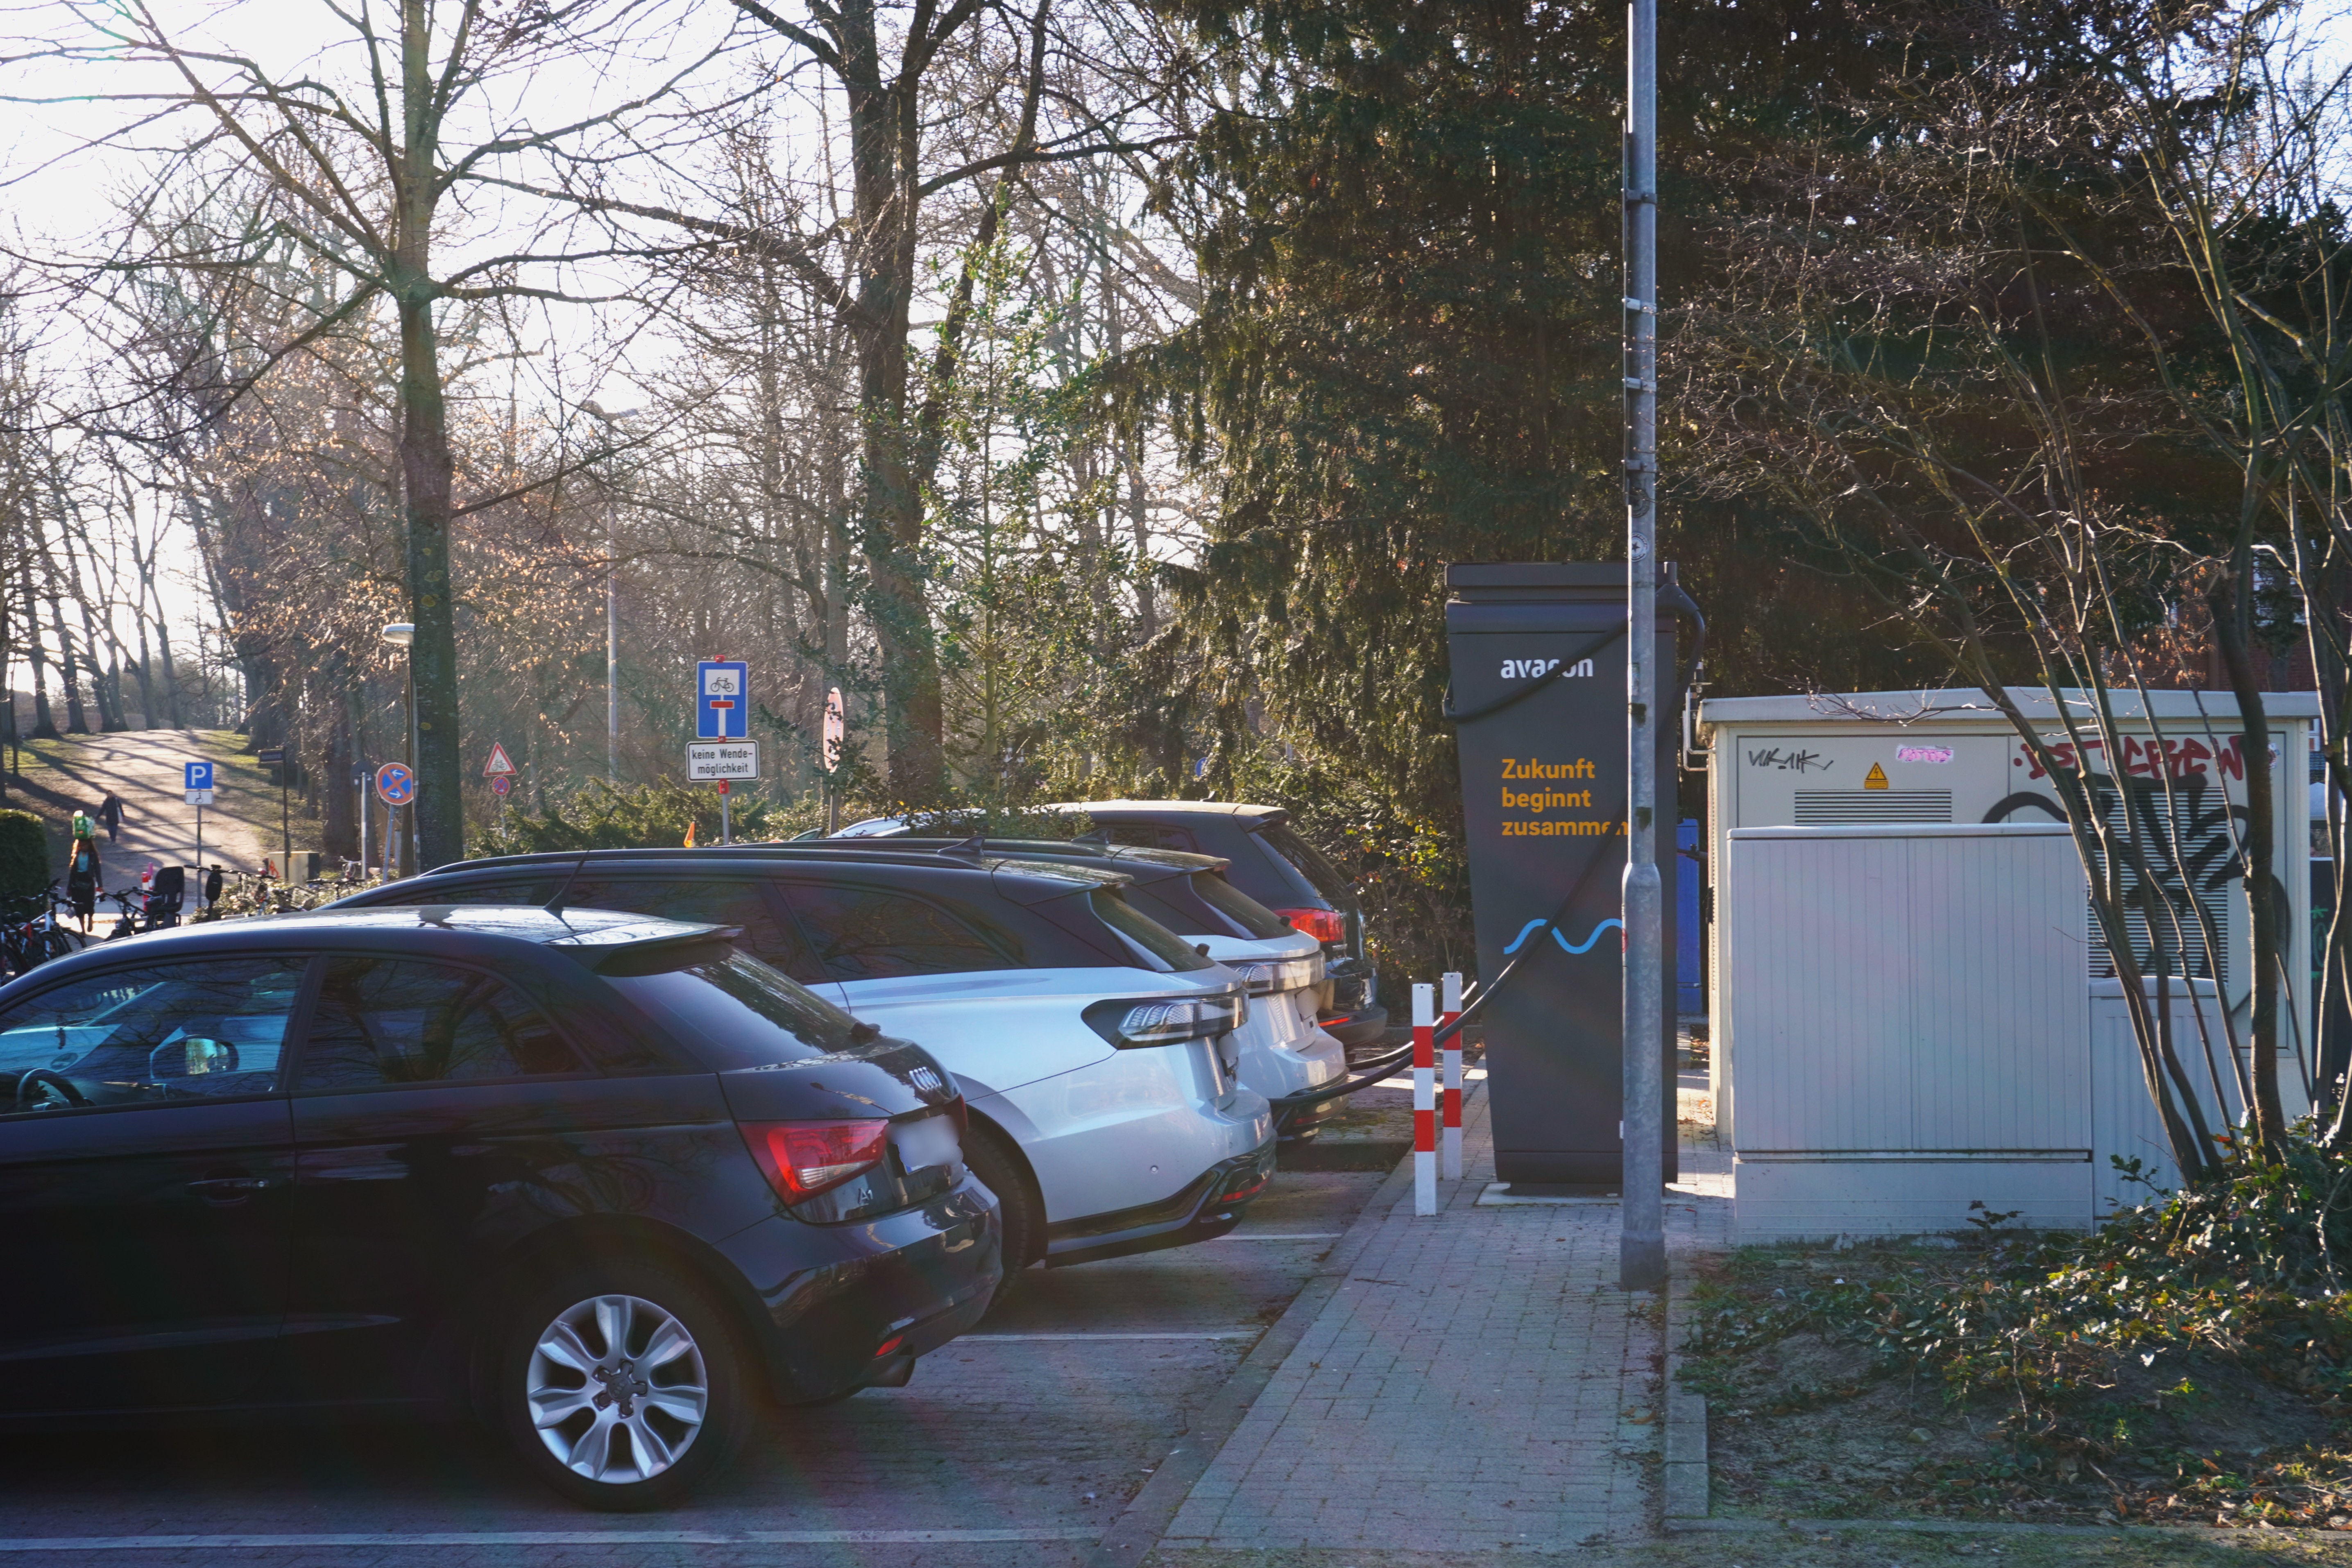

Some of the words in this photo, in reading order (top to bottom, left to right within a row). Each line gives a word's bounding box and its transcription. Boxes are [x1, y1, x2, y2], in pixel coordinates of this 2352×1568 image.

[692, 749, 715, 759] keine
[719, 748, 753, 758] Wende-
[191, 766, 206, 786] P
[698, 763, 748, 776] möglichkeit
[1502, 758, 1595, 778] Zukunft
[1502, 787, 1591, 813] beginnt
[858, 1188, 873, 1203] A1
